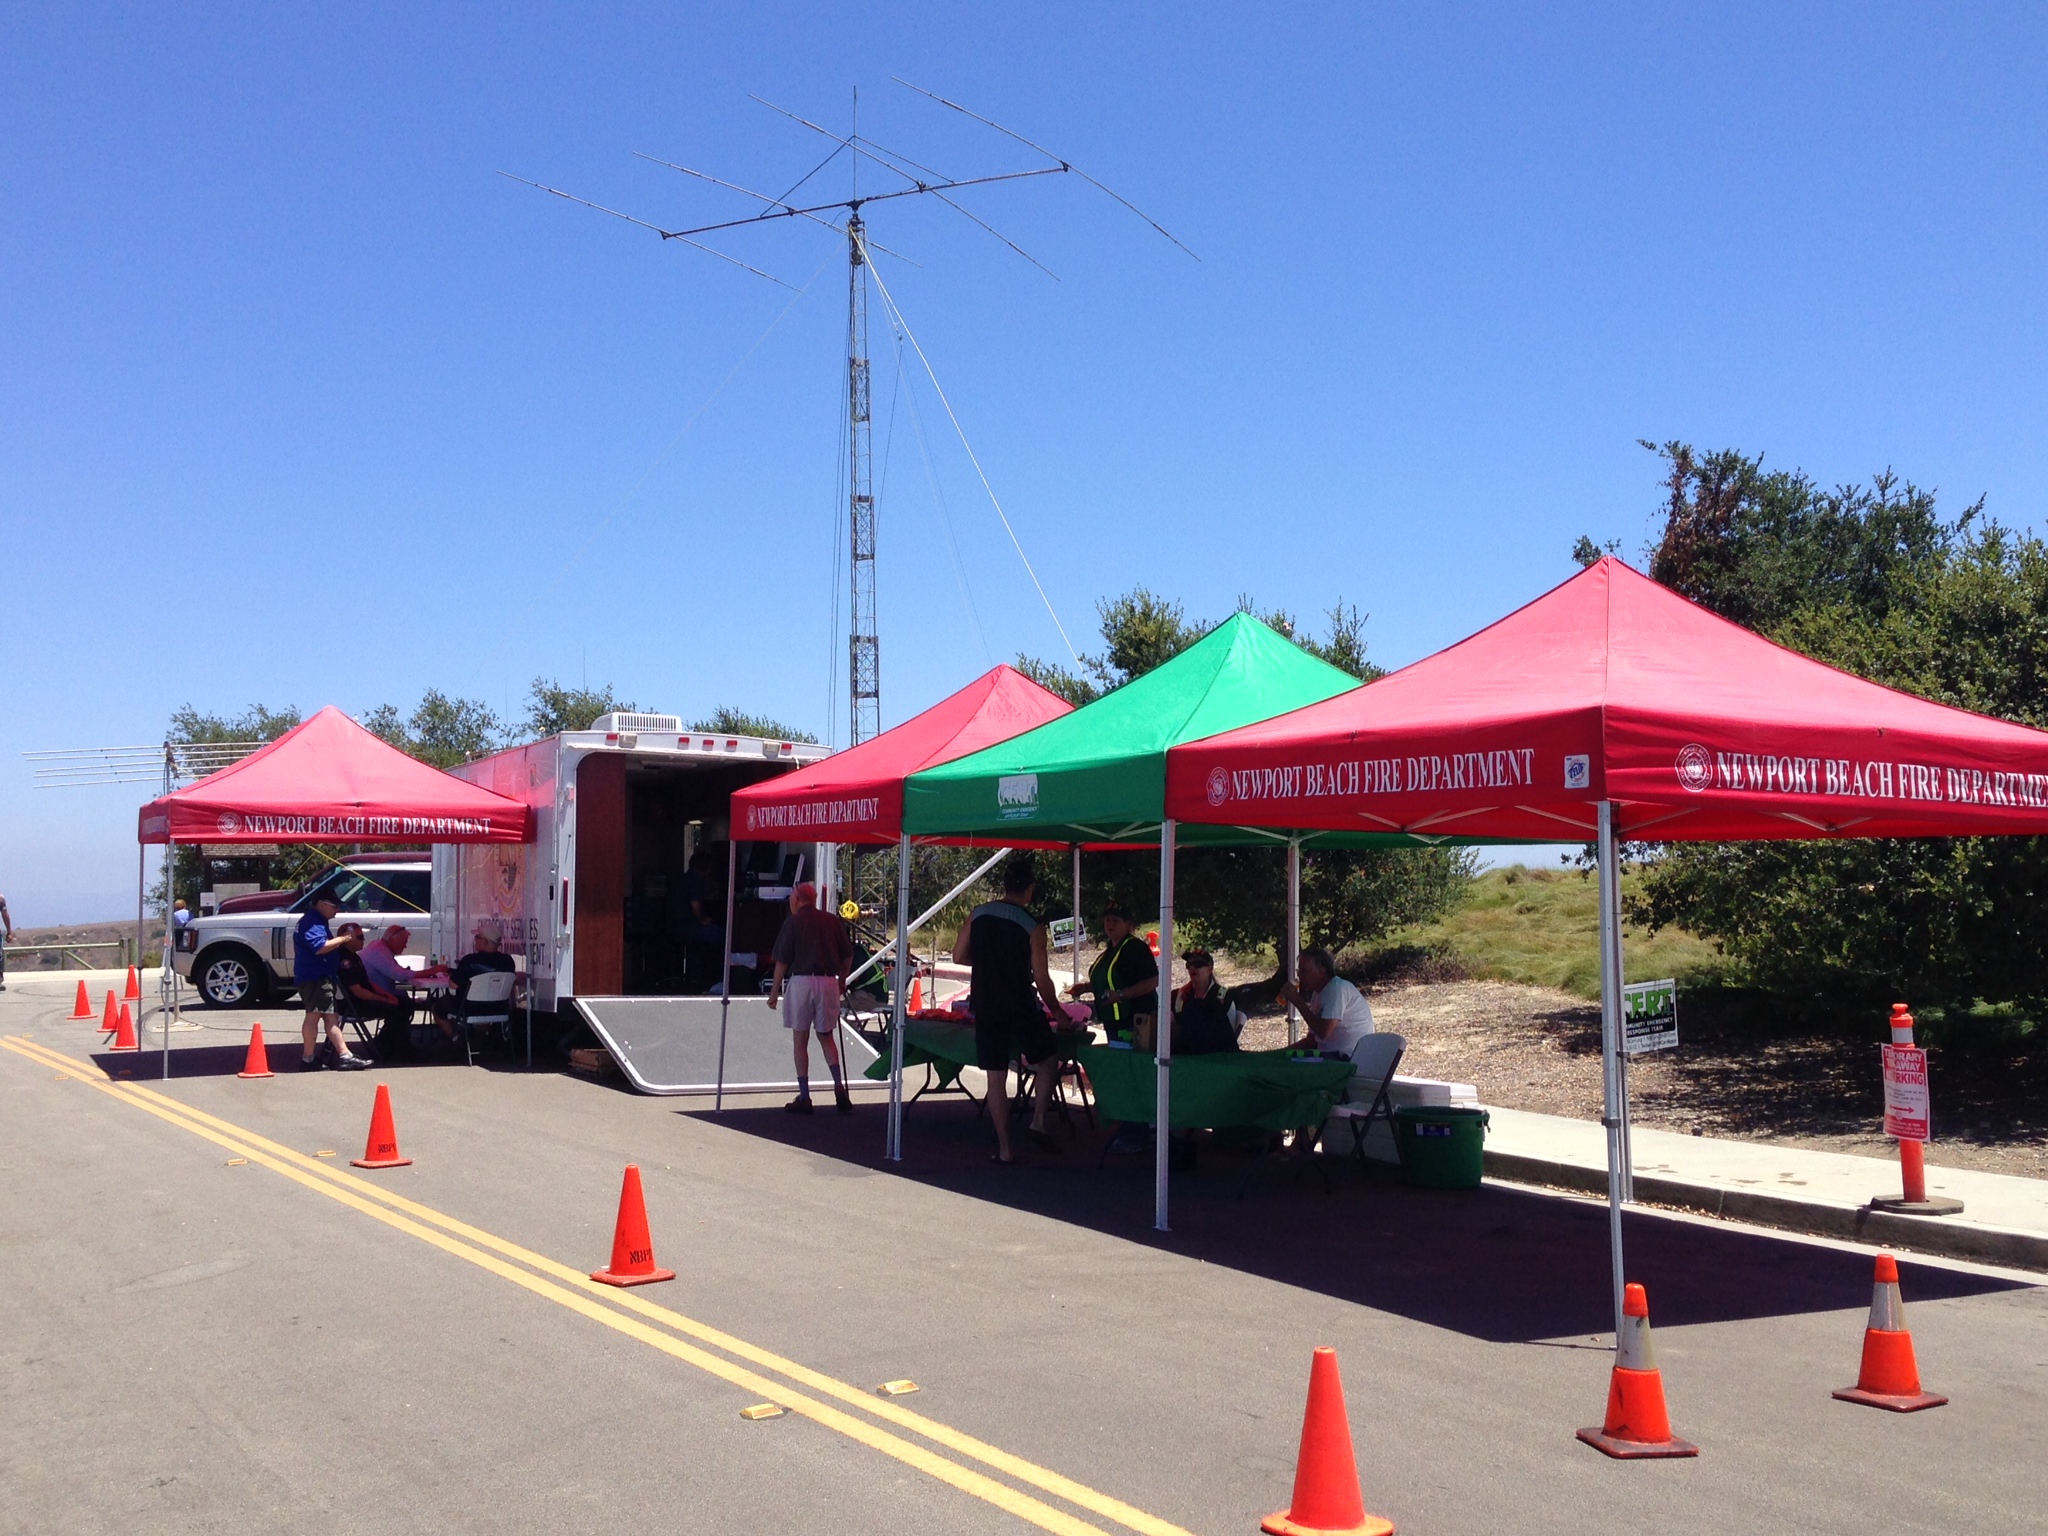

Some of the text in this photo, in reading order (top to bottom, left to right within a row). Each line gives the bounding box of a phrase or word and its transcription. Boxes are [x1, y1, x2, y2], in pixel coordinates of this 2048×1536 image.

[1230, 766, 1302, 800] NEWPORT
[1305, 761, 1359, 796] BEACH
[1363, 758, 1402, 793] FIRE
[1406, 748, 1534, 791] DEPARTMENT
[1716, 751, 2048, 808] NEWPORT BEACH FIRE DEPARTME
[244, 815, 315, 834] NEWPORT
[318, 816, 365, 835] BEACH
[368, 816, 400, 835] FIRE
[402, 817, 492, 836] DEPARTMENT
[757, 805, 788, 828] NEWPORT
[788, 803, 811, 826] BEACH
[811, 802, 828, 825] FIRE
[828, 797, 880, 823] DEPARTMENT
